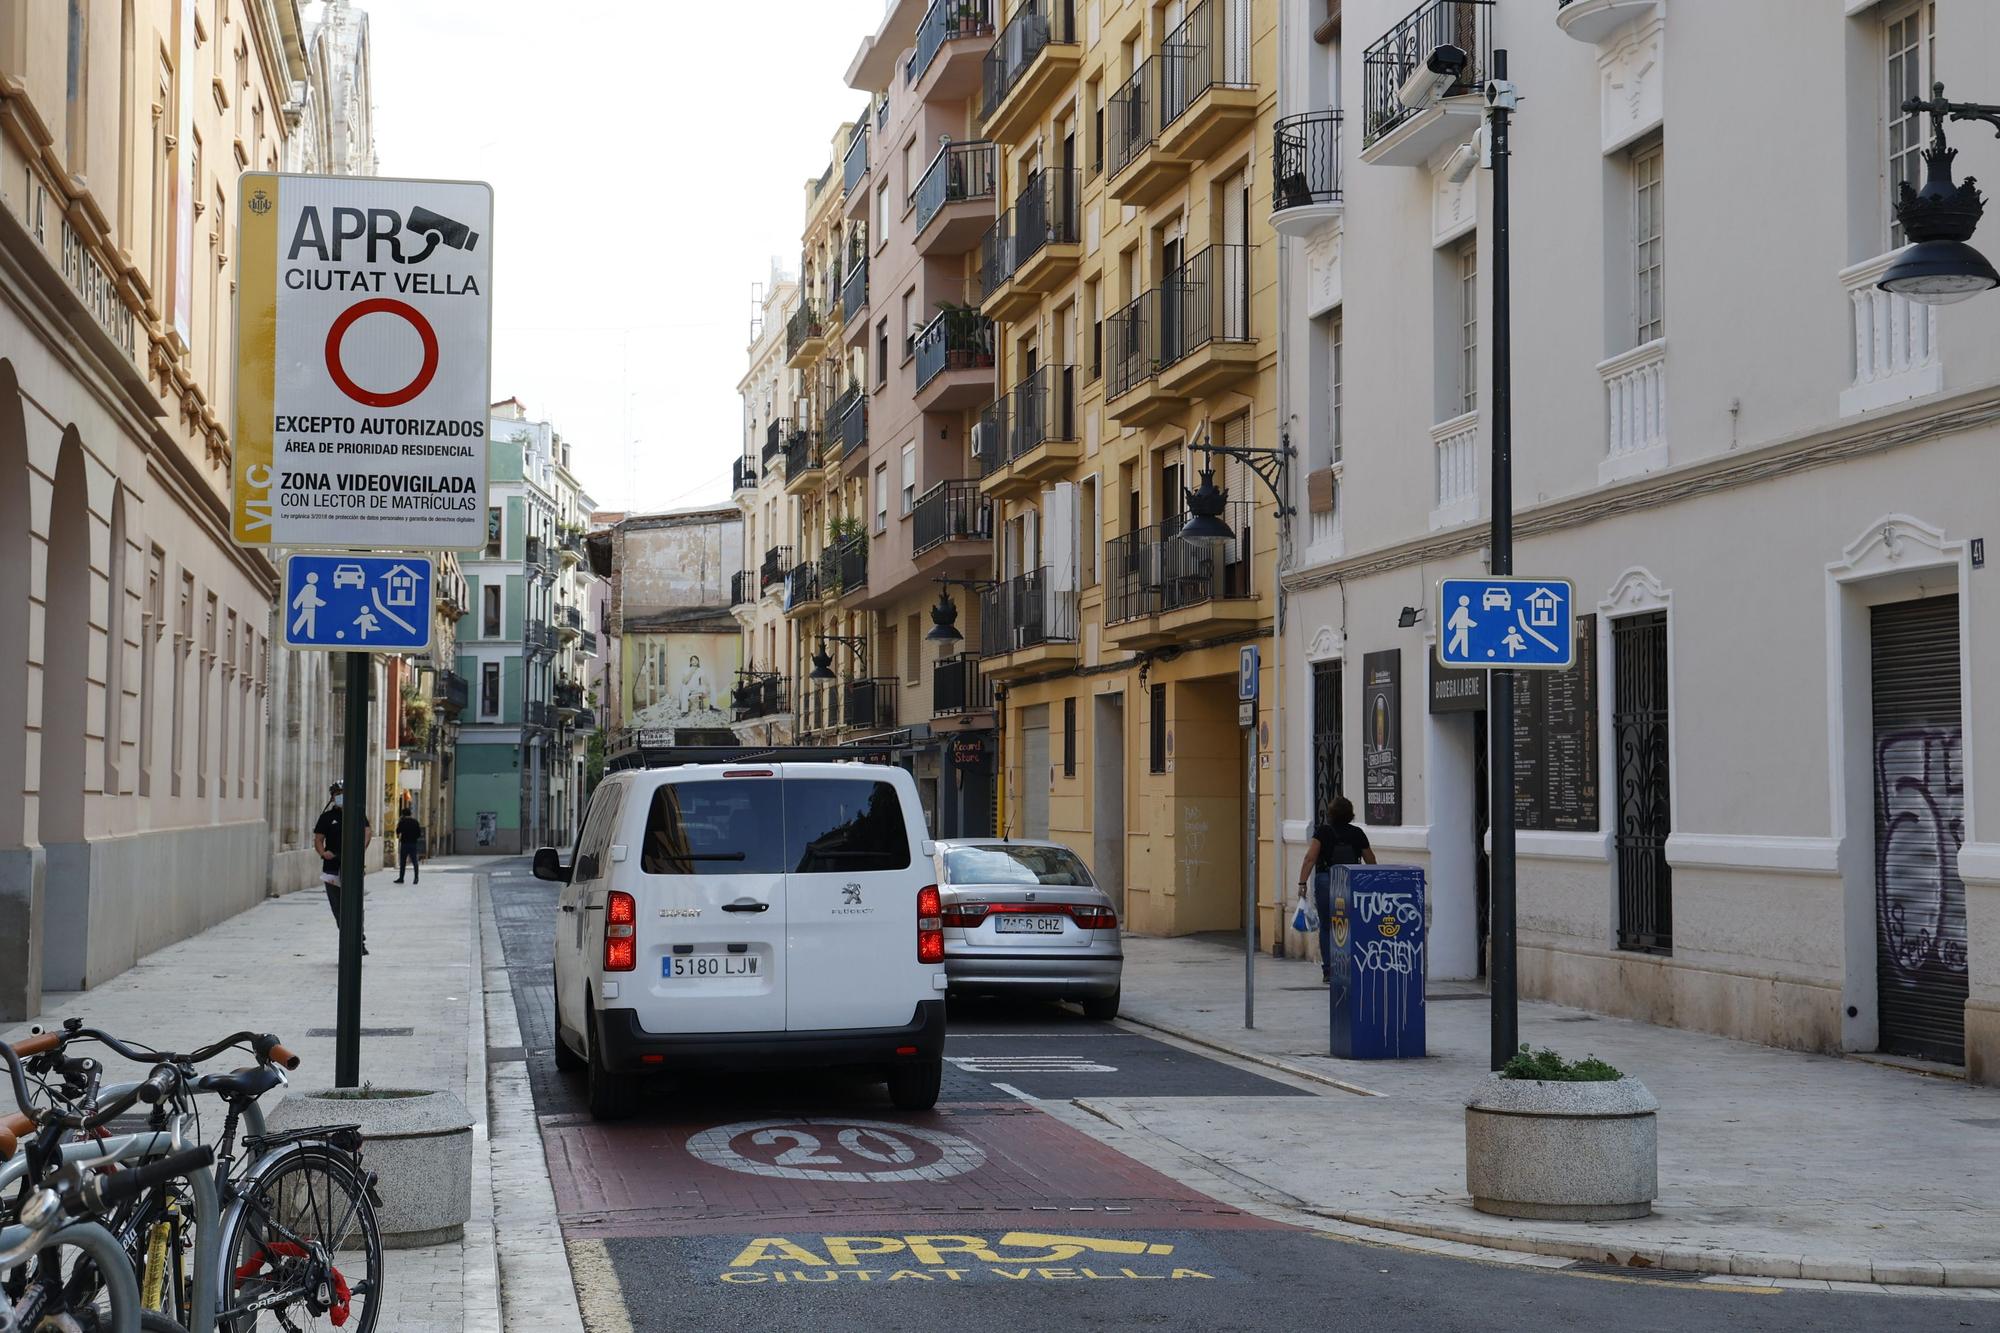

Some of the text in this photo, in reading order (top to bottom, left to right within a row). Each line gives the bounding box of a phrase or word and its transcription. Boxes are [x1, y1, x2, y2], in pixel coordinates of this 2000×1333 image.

[287, 205, 406, 265] APR
[284, 268, 480, 296] CIUTAT VELLA
[275, 415, 484, 438] EXCEPTO AUTORIZADOS
[285, 439, 475, 457] ÁREA DE PRIORIDAD RESIDENCIAL
[281, 472, 476, 494] ZONA VIDEOVIGILADA
[245, 463, 274, 531] VLC
[280, 493, 476, 510] CON LECTOR DE MATRÍCULAS
[1974, 542, 1982, 561] 41
[1436, 676, 1479, 698] BODEGA LA BENE
[659, 909, 702, 918] EXPERT
[1038, 918, 1060, 930] CHZ
[675, 958, 757, 975] 5180 LJW
[751, 1128, 916, 1164] 20
[728, 1234, 1001, 1266] APR
[720, 1268, 1216, 1284] CIUTAT VELLA
[247, 1291, 293, 1312] ORBEA
